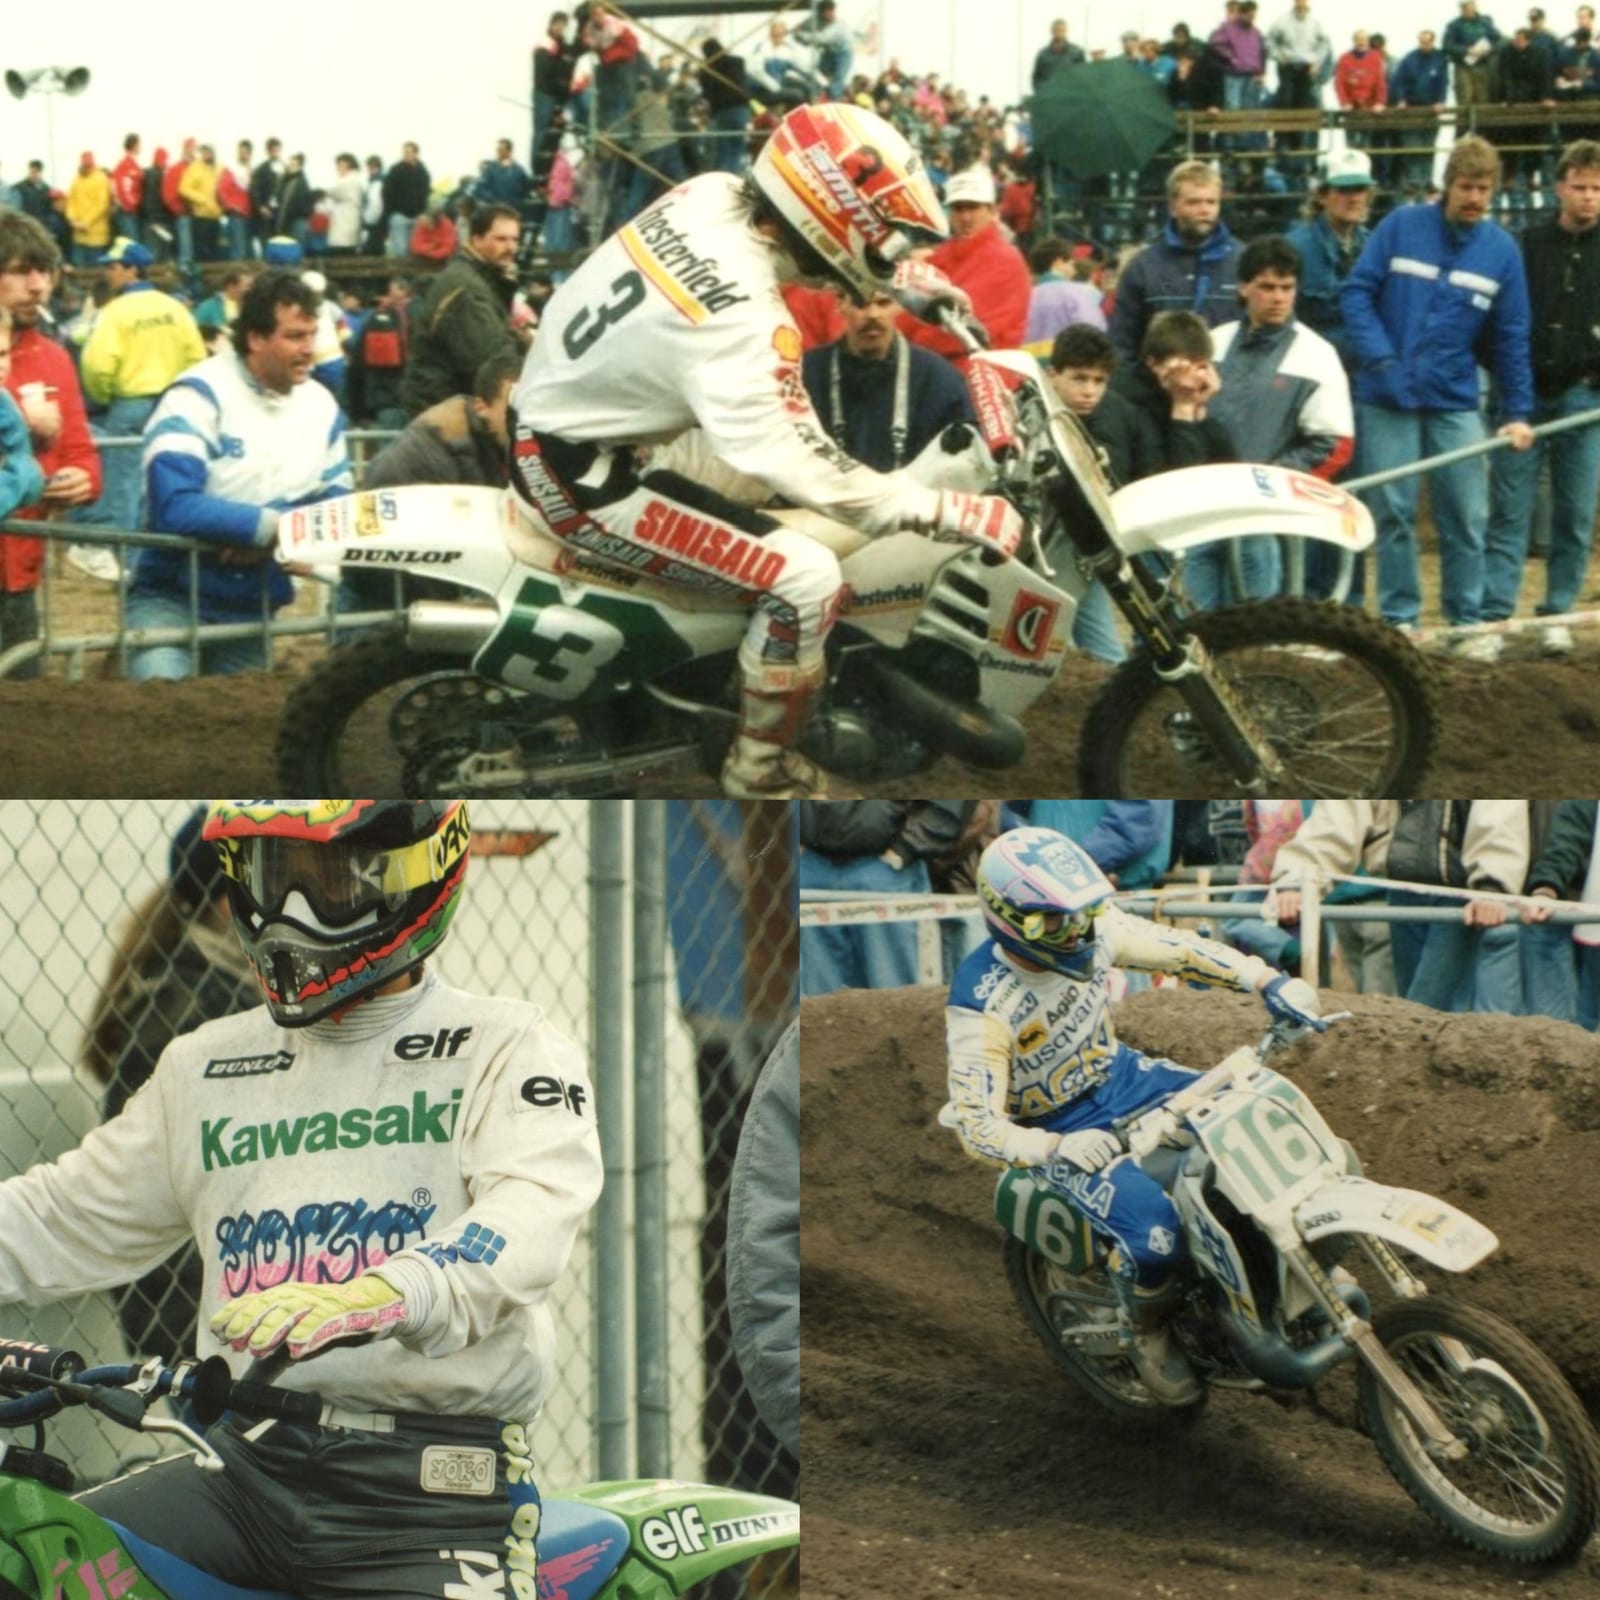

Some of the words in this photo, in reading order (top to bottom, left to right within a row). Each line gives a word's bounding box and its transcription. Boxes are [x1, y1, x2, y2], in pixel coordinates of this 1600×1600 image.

[636, 200, 750, 315] hesterfield
[562, 269, 646, 361] 3
[342, 549, 462, 565] DUNLOP
[634, 499, 787, 589] SINISALO
[503, 604, 625, 700] 3
[394, 1026, 473, 1061] elf
[1010, 967, 1106, 1081] Husqvarna
[1045, 984, 1080, 1028] Agip
[200, 1088, 464, 1172] Kawasaki
[521, 1075, 586, 1116] elf
[1221, 1097, 1324, 1202] 16
[1010, 1175, 1076, 1266] 16
[430, 1458, 489, 1482] YOKO
[641, 1503, 709, 1561] elf
